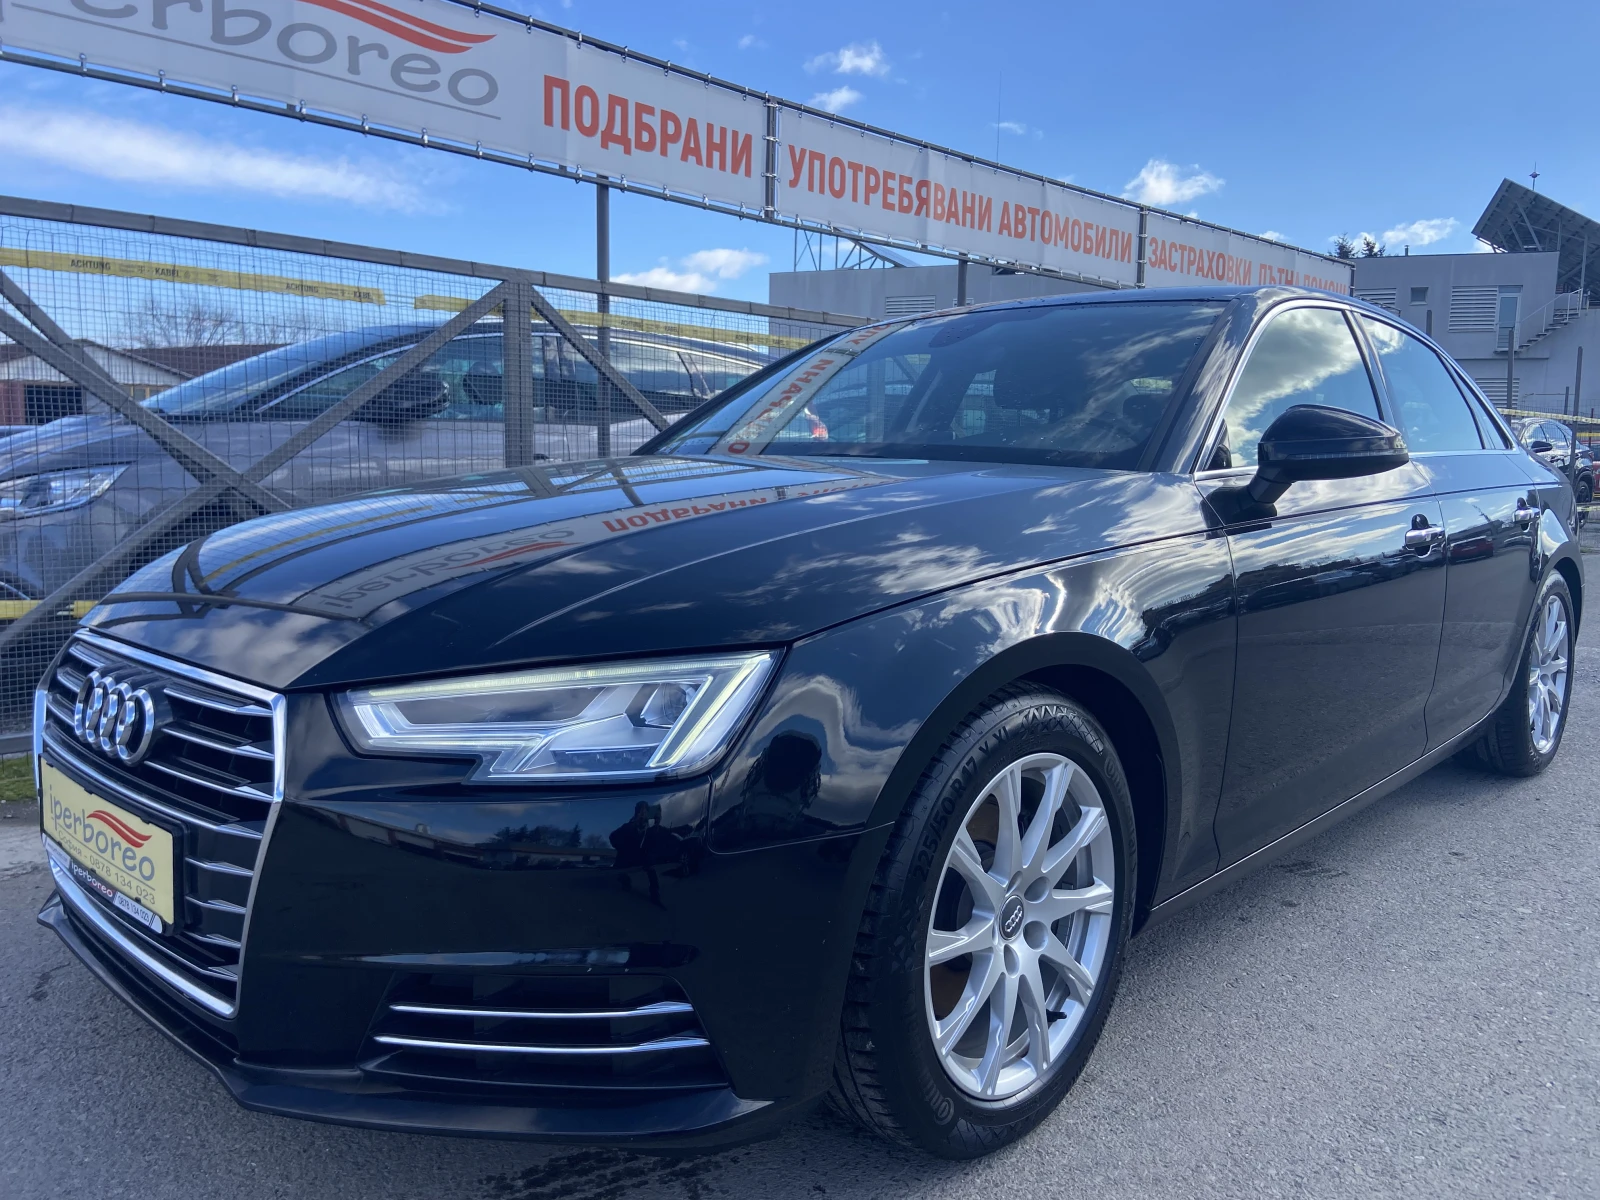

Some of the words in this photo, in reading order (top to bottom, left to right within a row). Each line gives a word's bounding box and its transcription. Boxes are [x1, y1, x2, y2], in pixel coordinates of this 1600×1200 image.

[543, 74, 753, 178] ПОДБРАНИ
[788, 144, 993, 232] УПОТРЕБЯВАНИ
[998, 201, 1132, 264] АВТОМОБИЛИ
[70, 259, 111, 271] ACHTUNG
[155, 267, 179, 278] KABEL
[1148, 237, 1252, 286] ЗАСТРАХОВКИ
[49, 784, 156, 882] iperboreo
[89, 854, 112, 877] 0878
[114, 871, 133, 891] 134
[135, 884, 156, 906] 023
